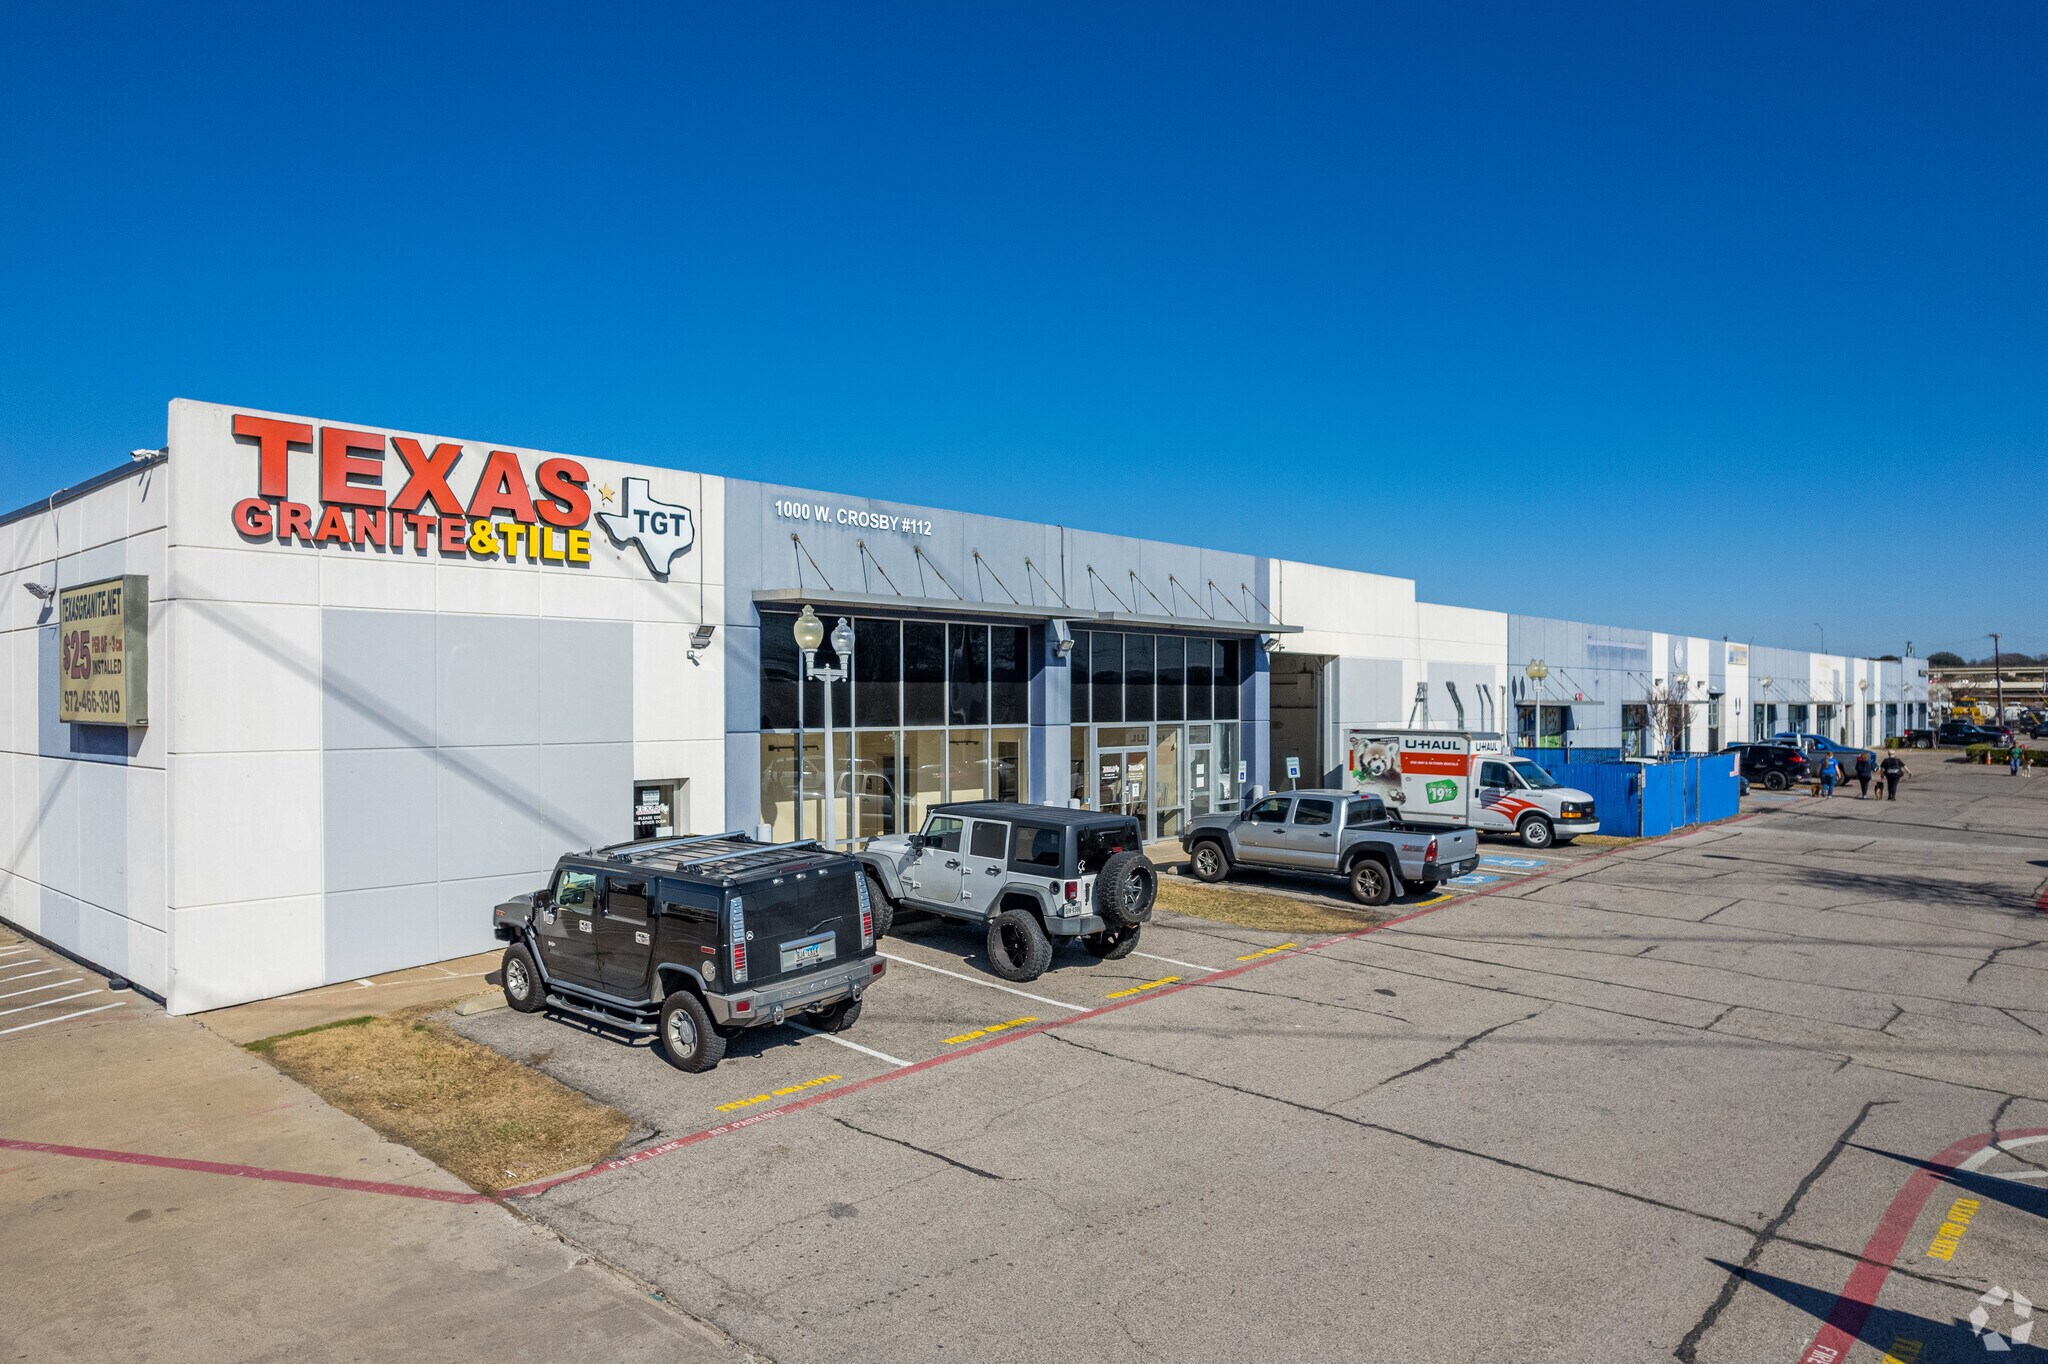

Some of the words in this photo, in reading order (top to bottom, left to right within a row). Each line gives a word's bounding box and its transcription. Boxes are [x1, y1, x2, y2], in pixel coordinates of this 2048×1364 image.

[232, 413, 593, 528] TEXAS
[632, 508, 687, 538] TGT
[775, 499, 811, 520] 1000
[814, 505, 833, 523] W.
[836, 508, 899, 532] CROSBY
[901, 517, 932, 536] #112
[62, 587, 122, 623] TEXASGRANITE.NET
[63, 630, 91, 680] $25
[92, 658, 122, 675] INSTALLED
[64, 690, 121, 714] 972-466-3919
[1405, 739, 1461, 751] U-HAUL
[1475, 742, 1498, 752] U-HAUL
[644, 1141, 684, 1157] LANE
[731, 1109, 785, 1130] PARKING
